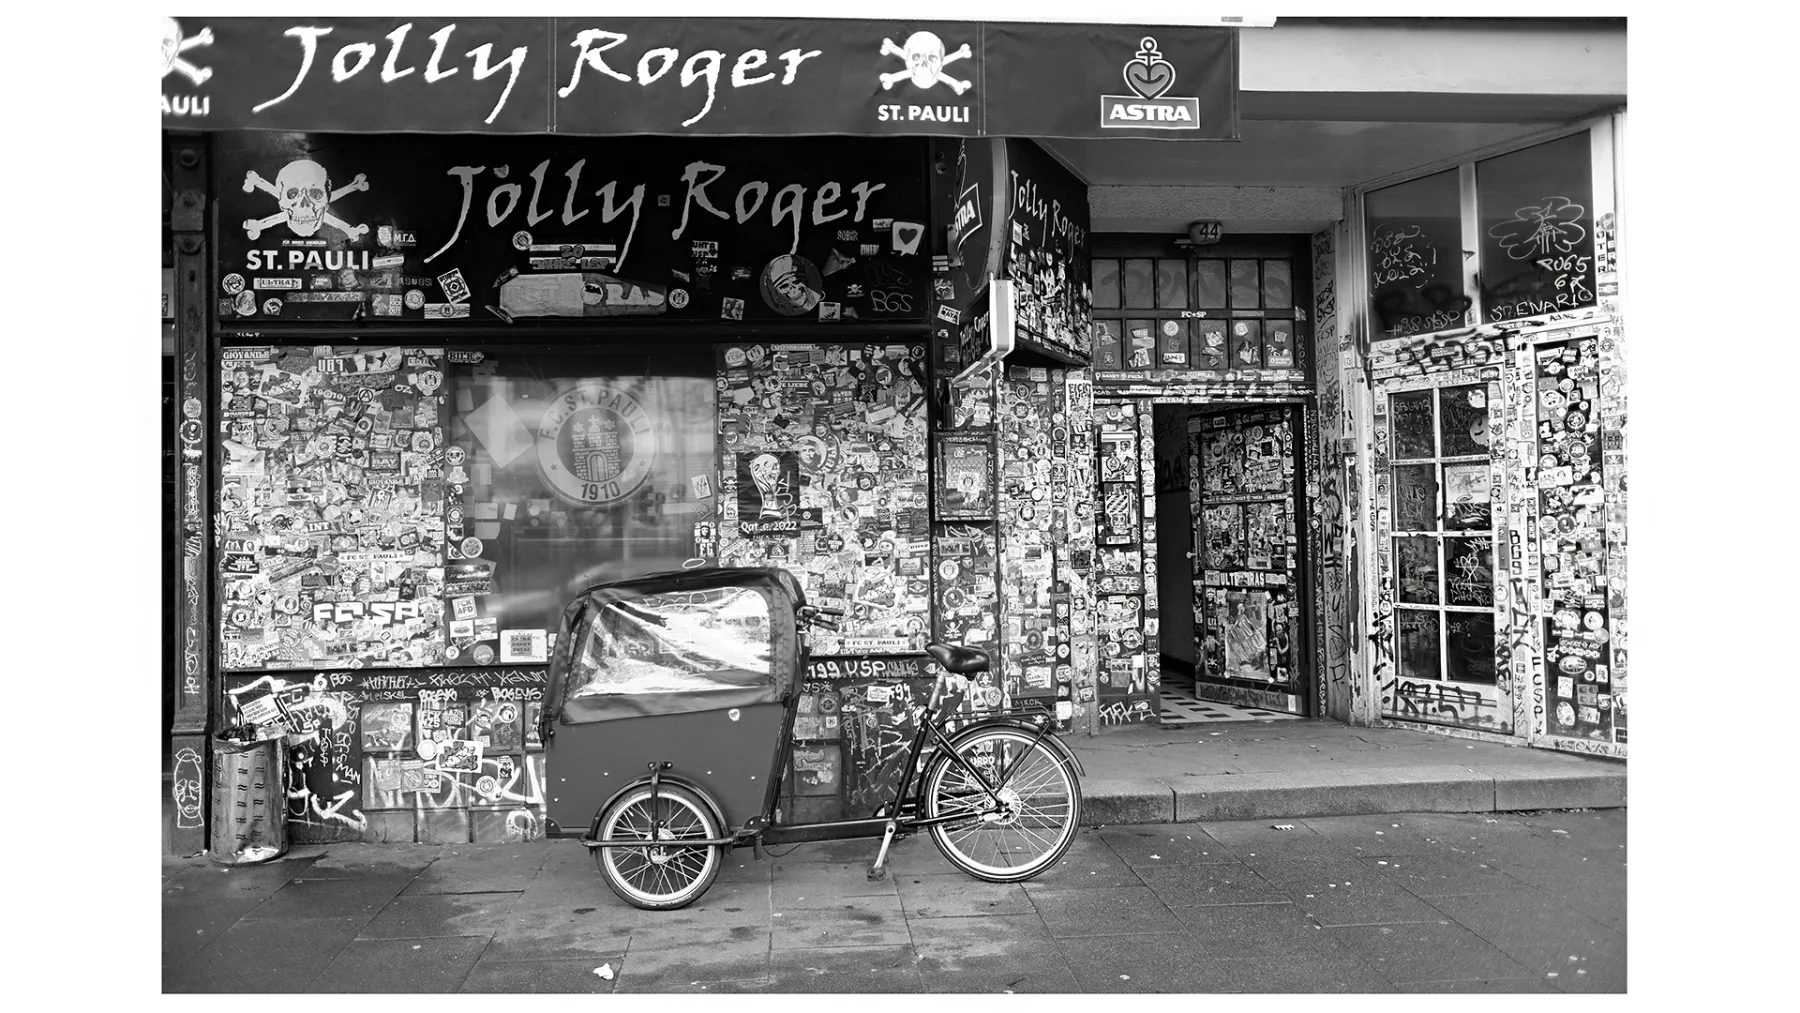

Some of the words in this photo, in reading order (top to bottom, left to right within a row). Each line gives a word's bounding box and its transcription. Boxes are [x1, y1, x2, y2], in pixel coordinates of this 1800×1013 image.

[252, 22, 528, 124] Jolly
[558, 28, 822, 127] Roger
[878, 105, 904, 122] ST.
[909, 105, 969, 123] PAULI
[1109, 104, 1191, 122] ASTRA
[424, 158, 646, 273] Jolly
[671, 160, 886, 255] Roger
[1008, 170, 1048, 248] Jolly
[1052, 199, 1086, 264] Roger
[1199, 225, 1219, 239] 44
[246, 250, 283, 270] ST.
[289, 250, 368, 270] PAULI
[597, 389, 652, 436] PAULI
[580, 480, 621, 501] 1910
[773, 520, 798, 532] 2022
[844, 660, 886, 678] USP
